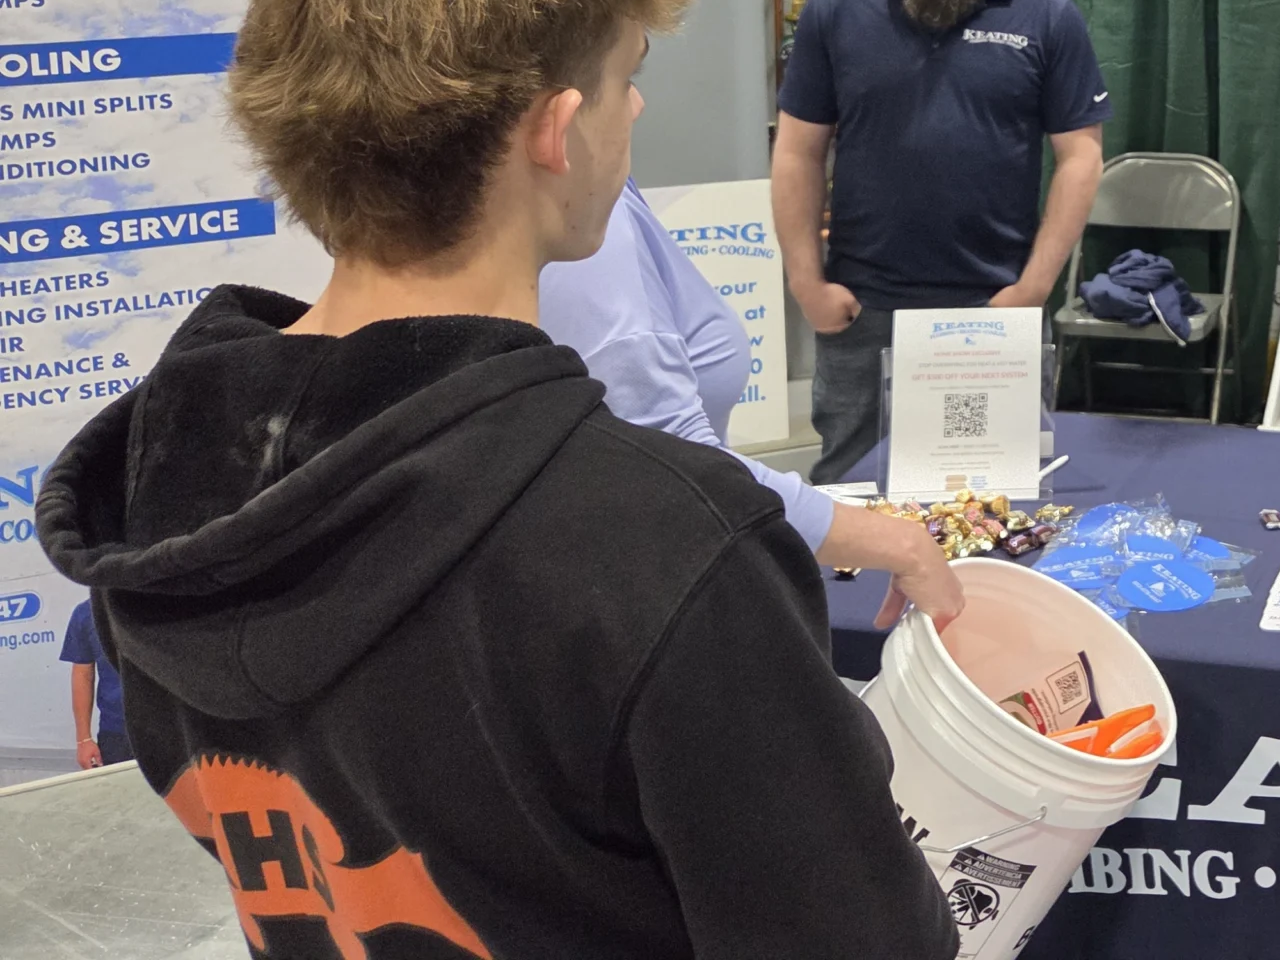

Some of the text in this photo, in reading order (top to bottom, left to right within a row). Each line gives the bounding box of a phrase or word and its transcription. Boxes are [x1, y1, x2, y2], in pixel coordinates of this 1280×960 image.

[962, 28, 1029, 47] KEATING
[22, 99, 85, 120] MINI
[94, 93, 173, 115] SPLITS
[0, 131, 56, 151] MPS
[60, 224, 91, 250] &
[100, 208, 240, 246] SERVICE
[718, 244, 775, 259] COOLING
[0, 271, 110, 297] HEATERS
[714, 281, 758, 296] our
[744, 305, 767, 320] at
[932, 321, 1005, 333] KEATING
[112, 352, 131, 369] &
[0, 375, 148, 410] ENCY SERV
[0, 518, 40, 544] CO
[972, 861, 1022, 879] ADVERTENCIA
[986, 855, 1021, 871] WARNING
